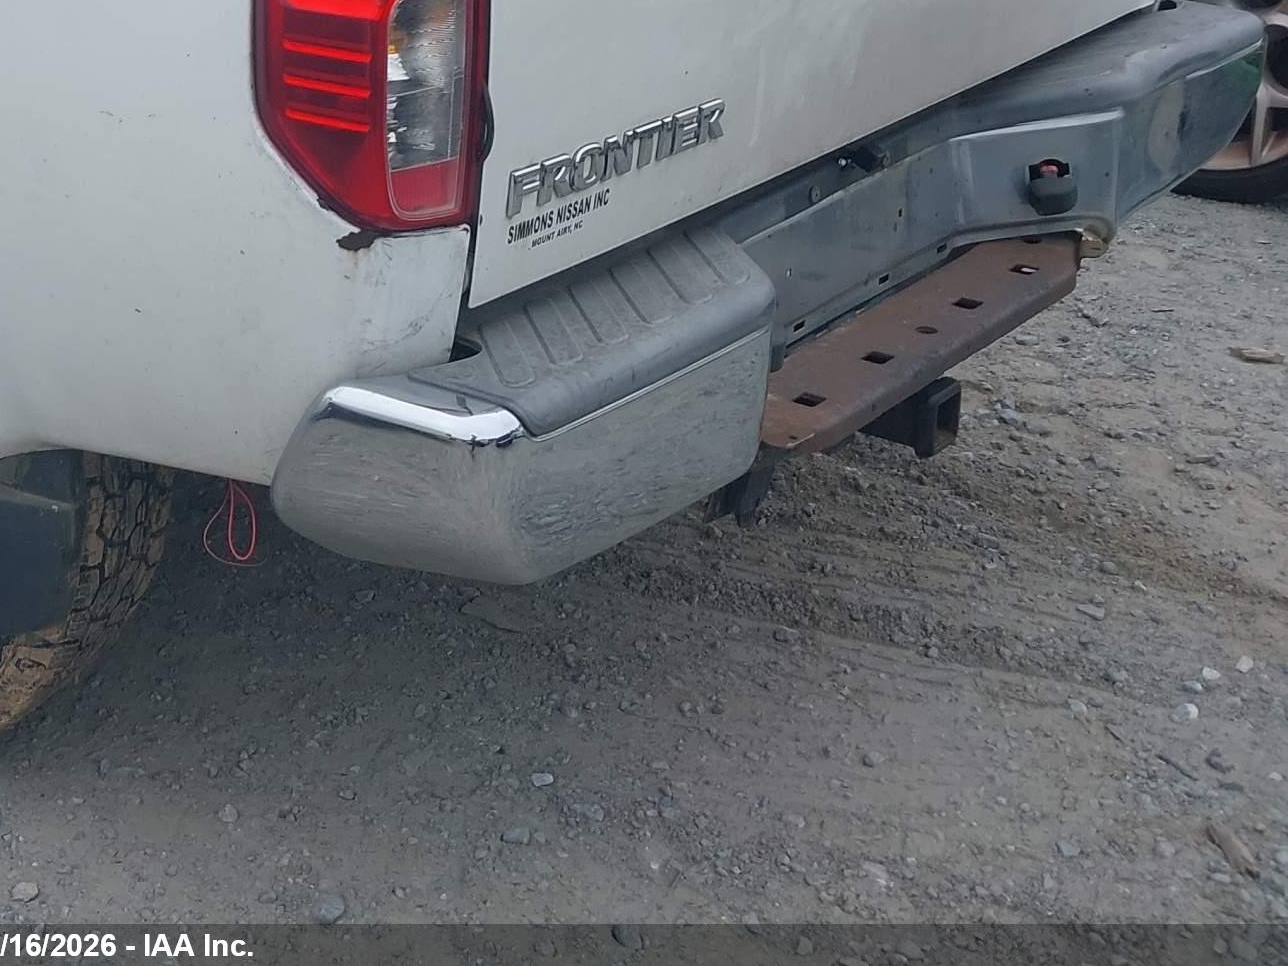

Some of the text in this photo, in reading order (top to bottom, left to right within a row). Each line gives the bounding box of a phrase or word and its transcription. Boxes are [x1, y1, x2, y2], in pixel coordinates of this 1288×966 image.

[505, 98, 726, 219] FRONTIER
[507, 188, 610, 244] SIMMONS NISSAN INC
[531, 231, 556, 248] MOUNT
[573, 220, 584, 232] NC
